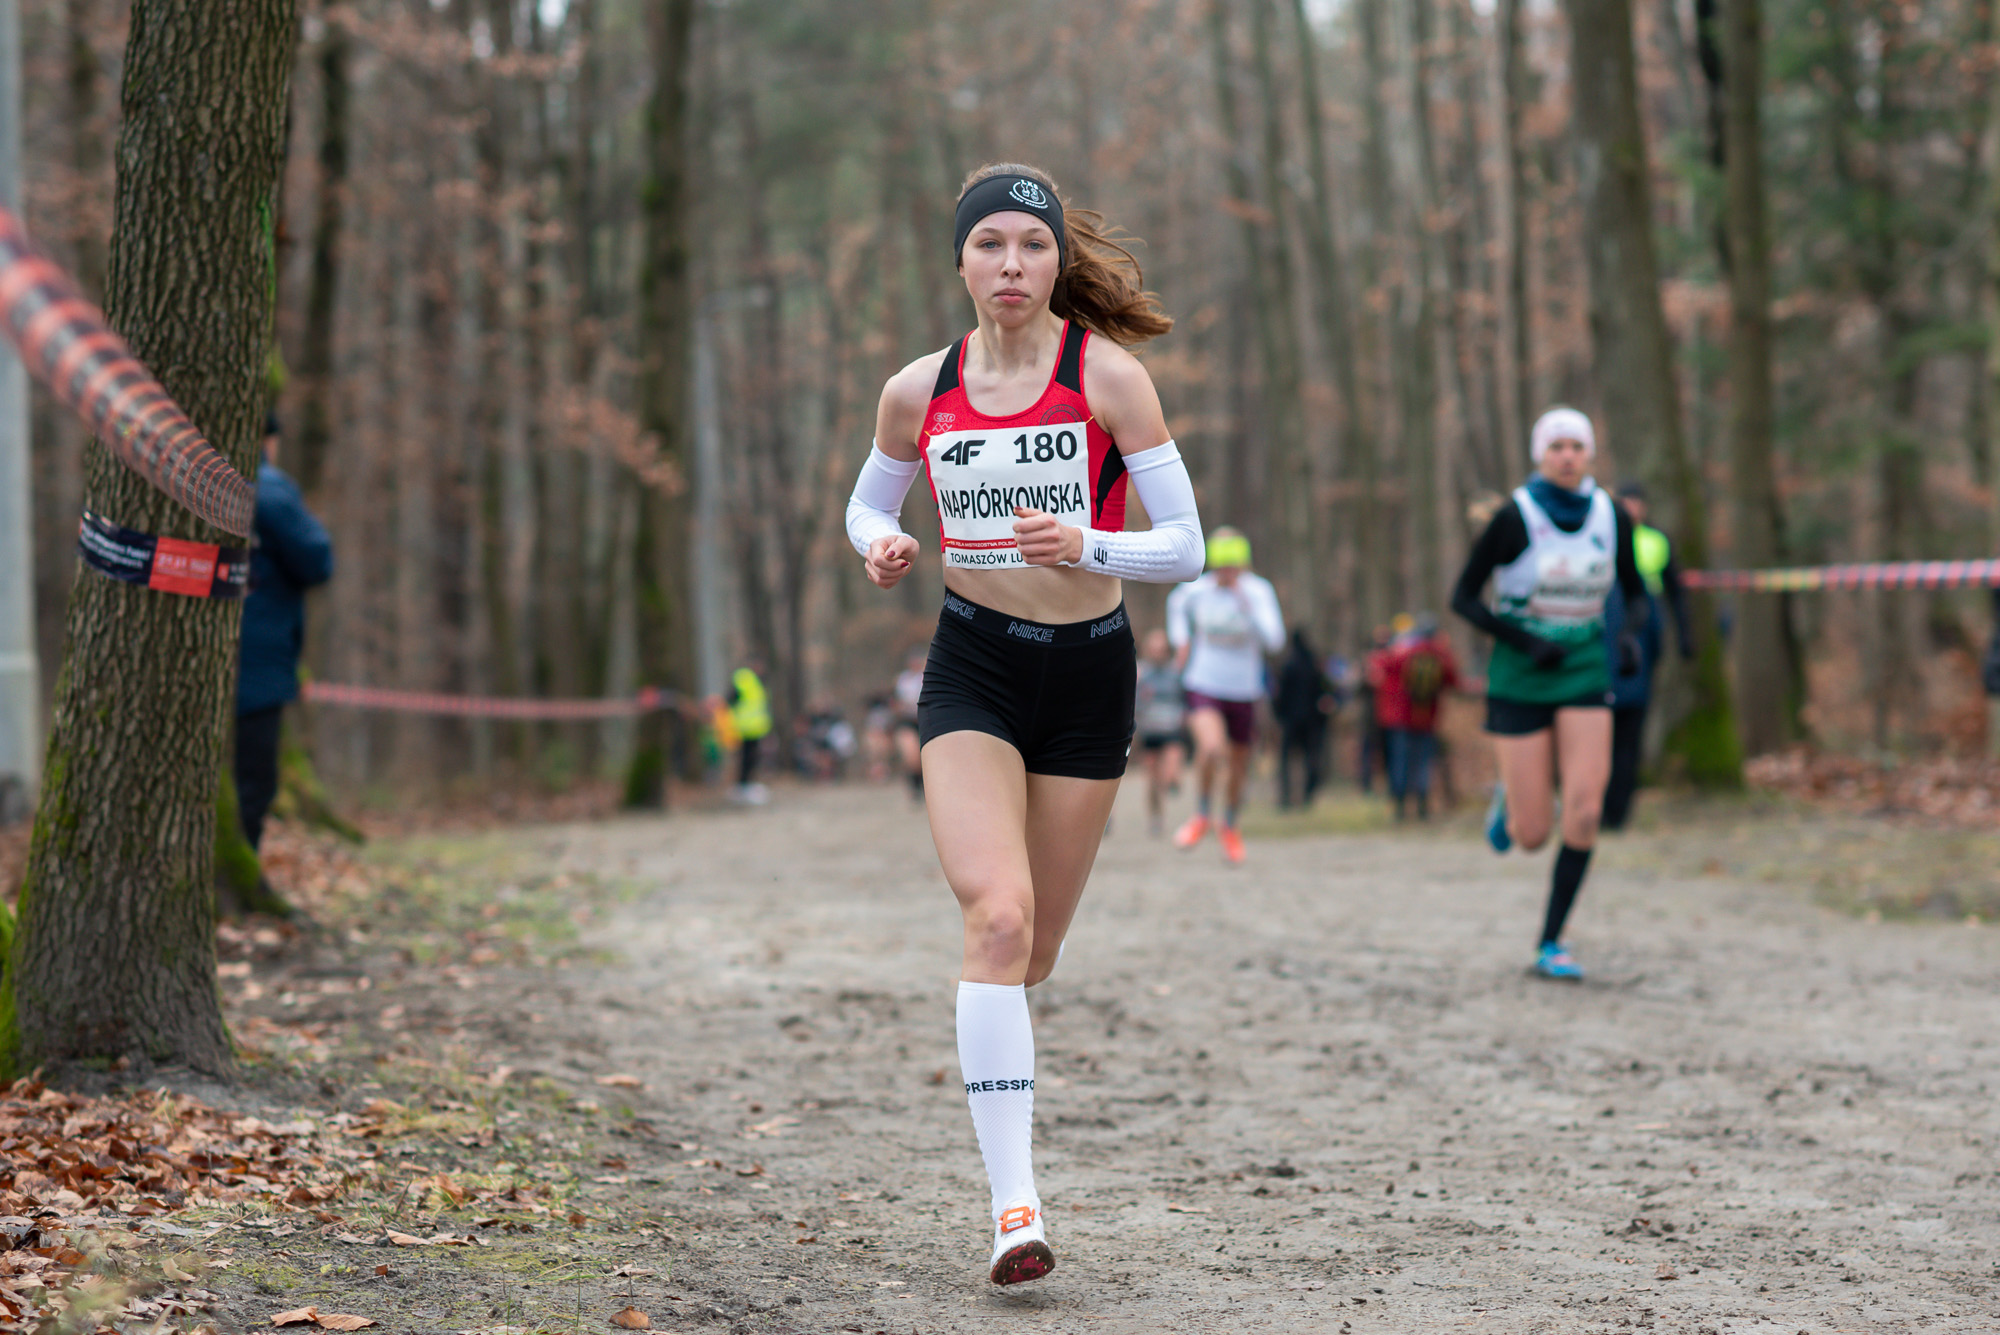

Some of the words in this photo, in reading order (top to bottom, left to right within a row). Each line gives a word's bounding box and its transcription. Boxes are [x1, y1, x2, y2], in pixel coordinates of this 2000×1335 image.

[941, 439, 986, 466] 4F
[1013, 430, 1078, 464] 180
[940, 482, 1085, 519] NAPIÓRKOWSKA
[951, 551, 1007, 564] TOMASZÓW
[944, 593, 976, 620] NIKE
[1007, 621, 1055, 643] NIKE
[1090, 611, 1124, 638] NIKE
